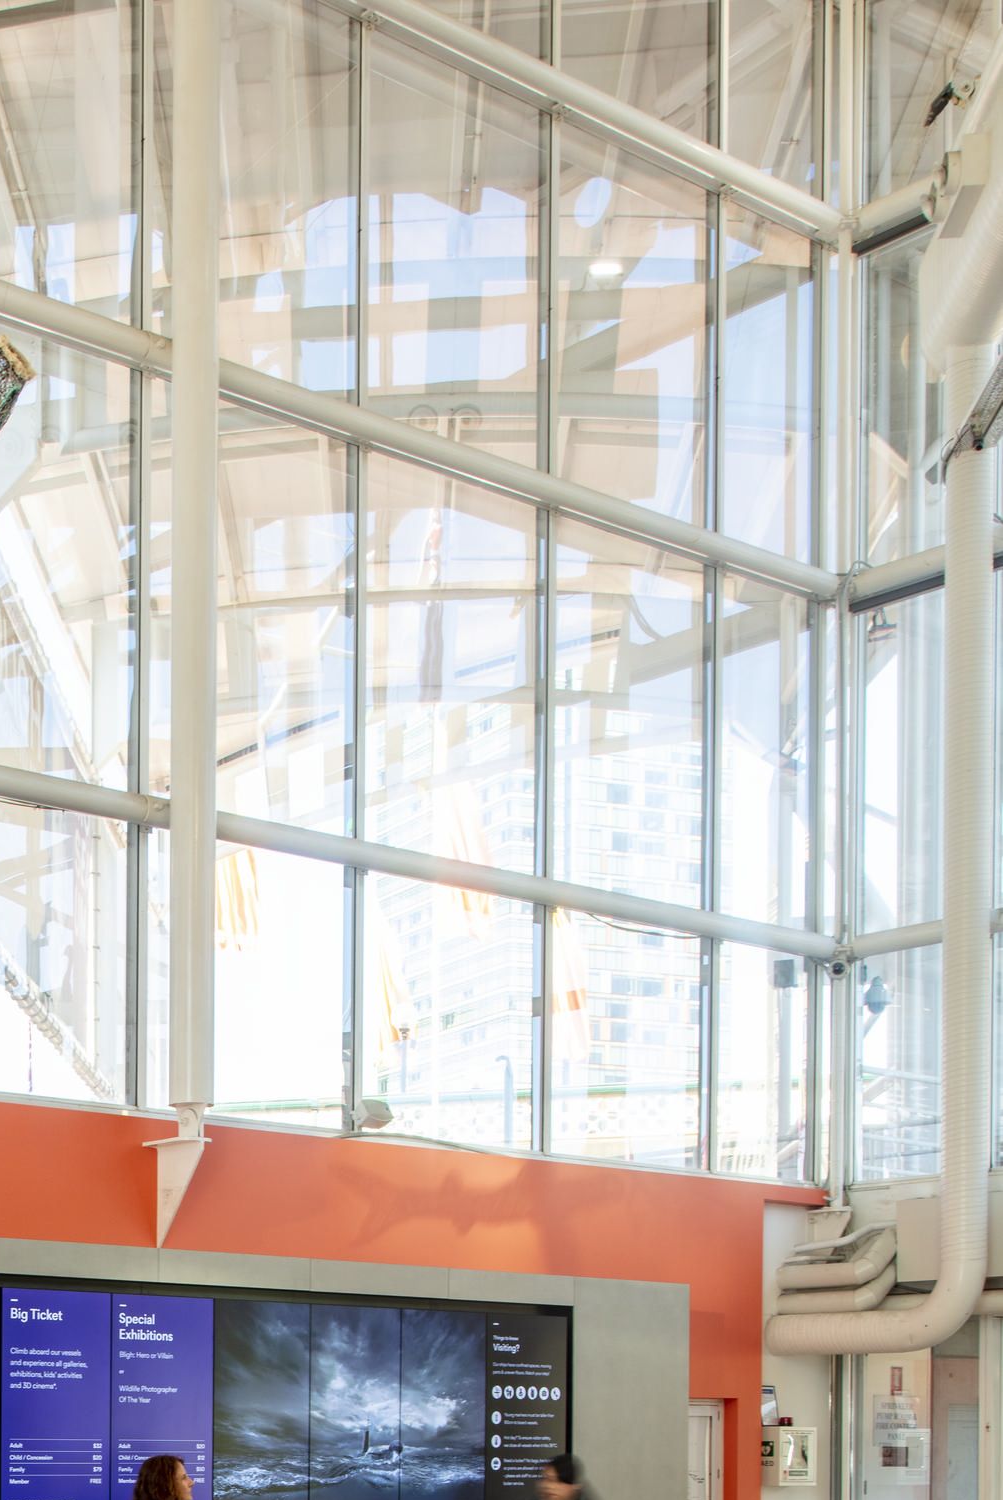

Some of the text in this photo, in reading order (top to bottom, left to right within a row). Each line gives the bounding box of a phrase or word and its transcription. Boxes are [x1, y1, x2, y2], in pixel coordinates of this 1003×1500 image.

[10, 1307, 64, 1323] Big Ticket
[118, 1312, 156, 1327] Special
[119, 1328, 174, 1342] Exhibitions
[493, 1343, 520, 1354] Visiting?
[119, 1351, 135, 1360] Bligh:
[63, 1360, 88, 1369] galleries,
[140, 1386, 178, 1394] Photographer
